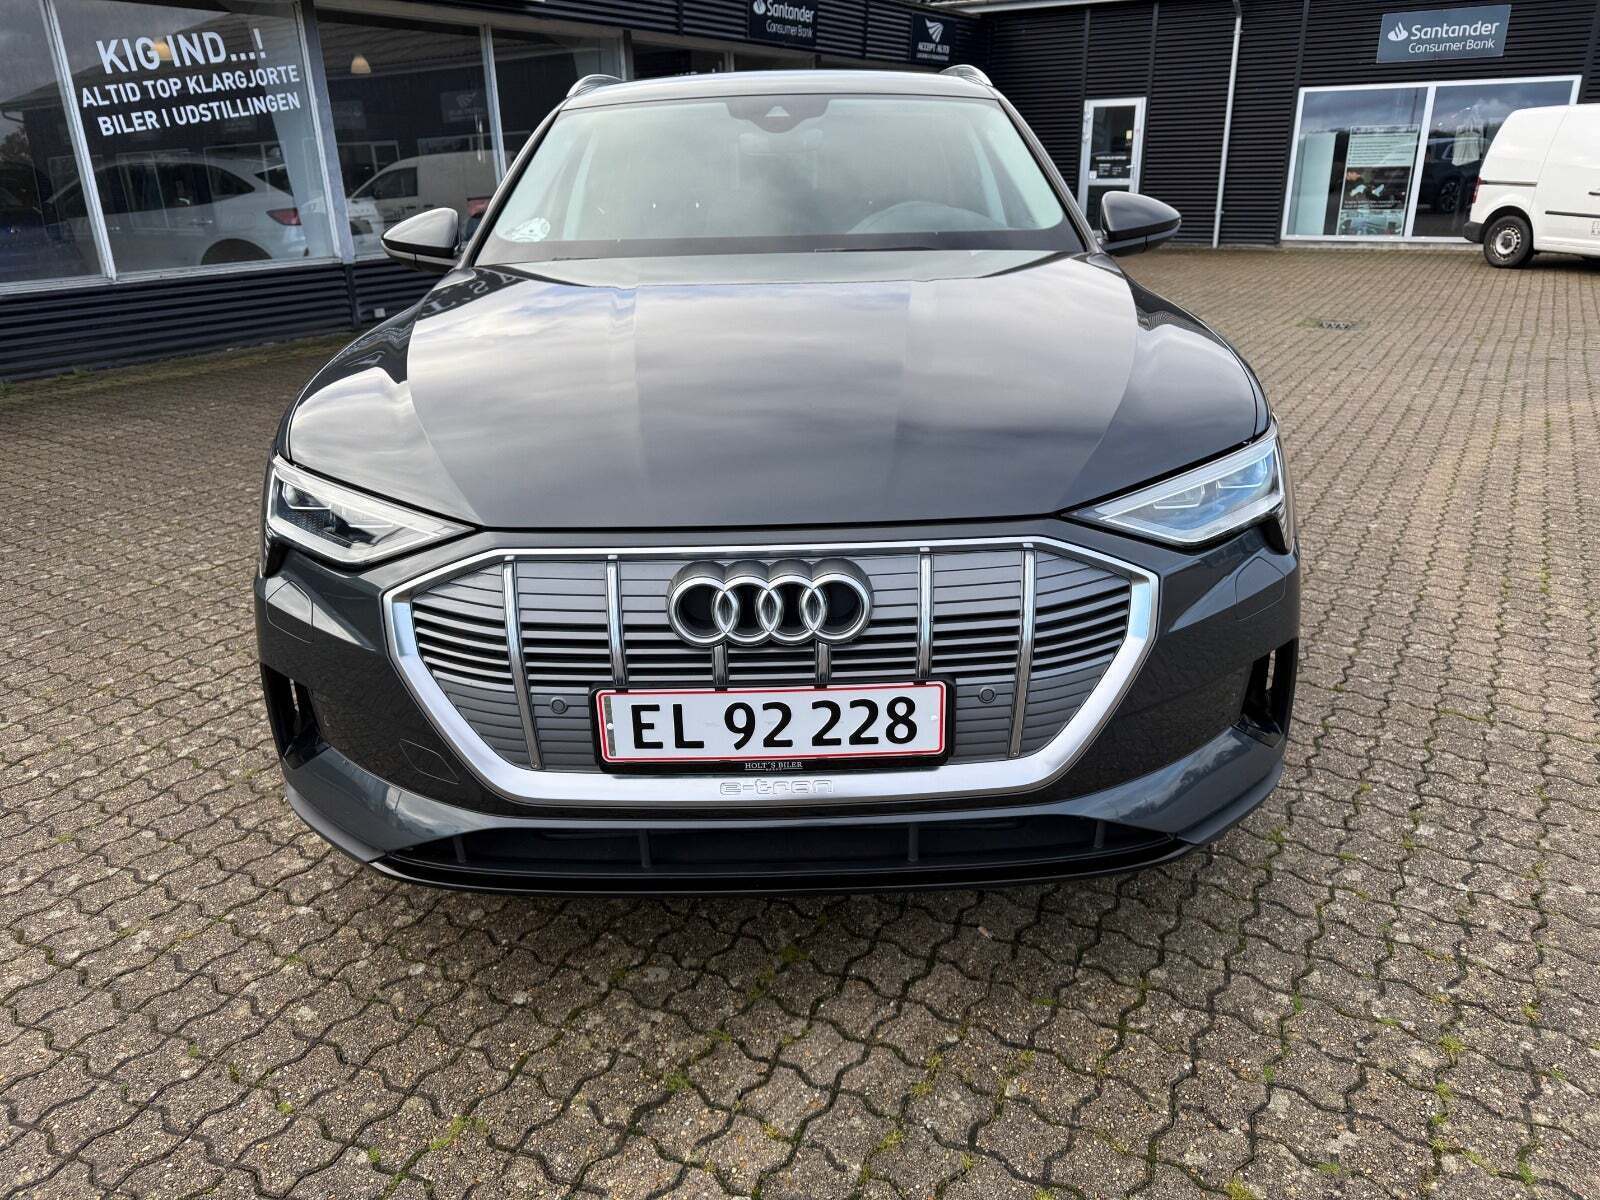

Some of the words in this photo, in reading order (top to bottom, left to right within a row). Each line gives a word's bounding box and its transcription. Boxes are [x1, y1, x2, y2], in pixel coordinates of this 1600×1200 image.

[766, 0, 815, 23] Santander
[766, 19, 798, 35] Consumer
[797, 24, 814, 37] Bank
[1410, 20, 1500, 40] Santander
[96, 36, 161, 74] KIG
[1408, 41, 1466, 53] Consumer
[1466, 38, 1495, 50] Bank
[82, 82, 141, 108] ALTID
[143, 78, 182, 100] TOP
[186, 64, 300, 95] KLARGJORTE
[97, 110, 160, 137] BILER
[162, 108, 171, 128] I
[172, 92, 301, 126] UDSTILLINGEN
[631, 703, 704, 749] EL
[724, 701, 793, 750] 92
[811, 696, 918, 747] 228
[719, 777, 834, 796] e-tron
